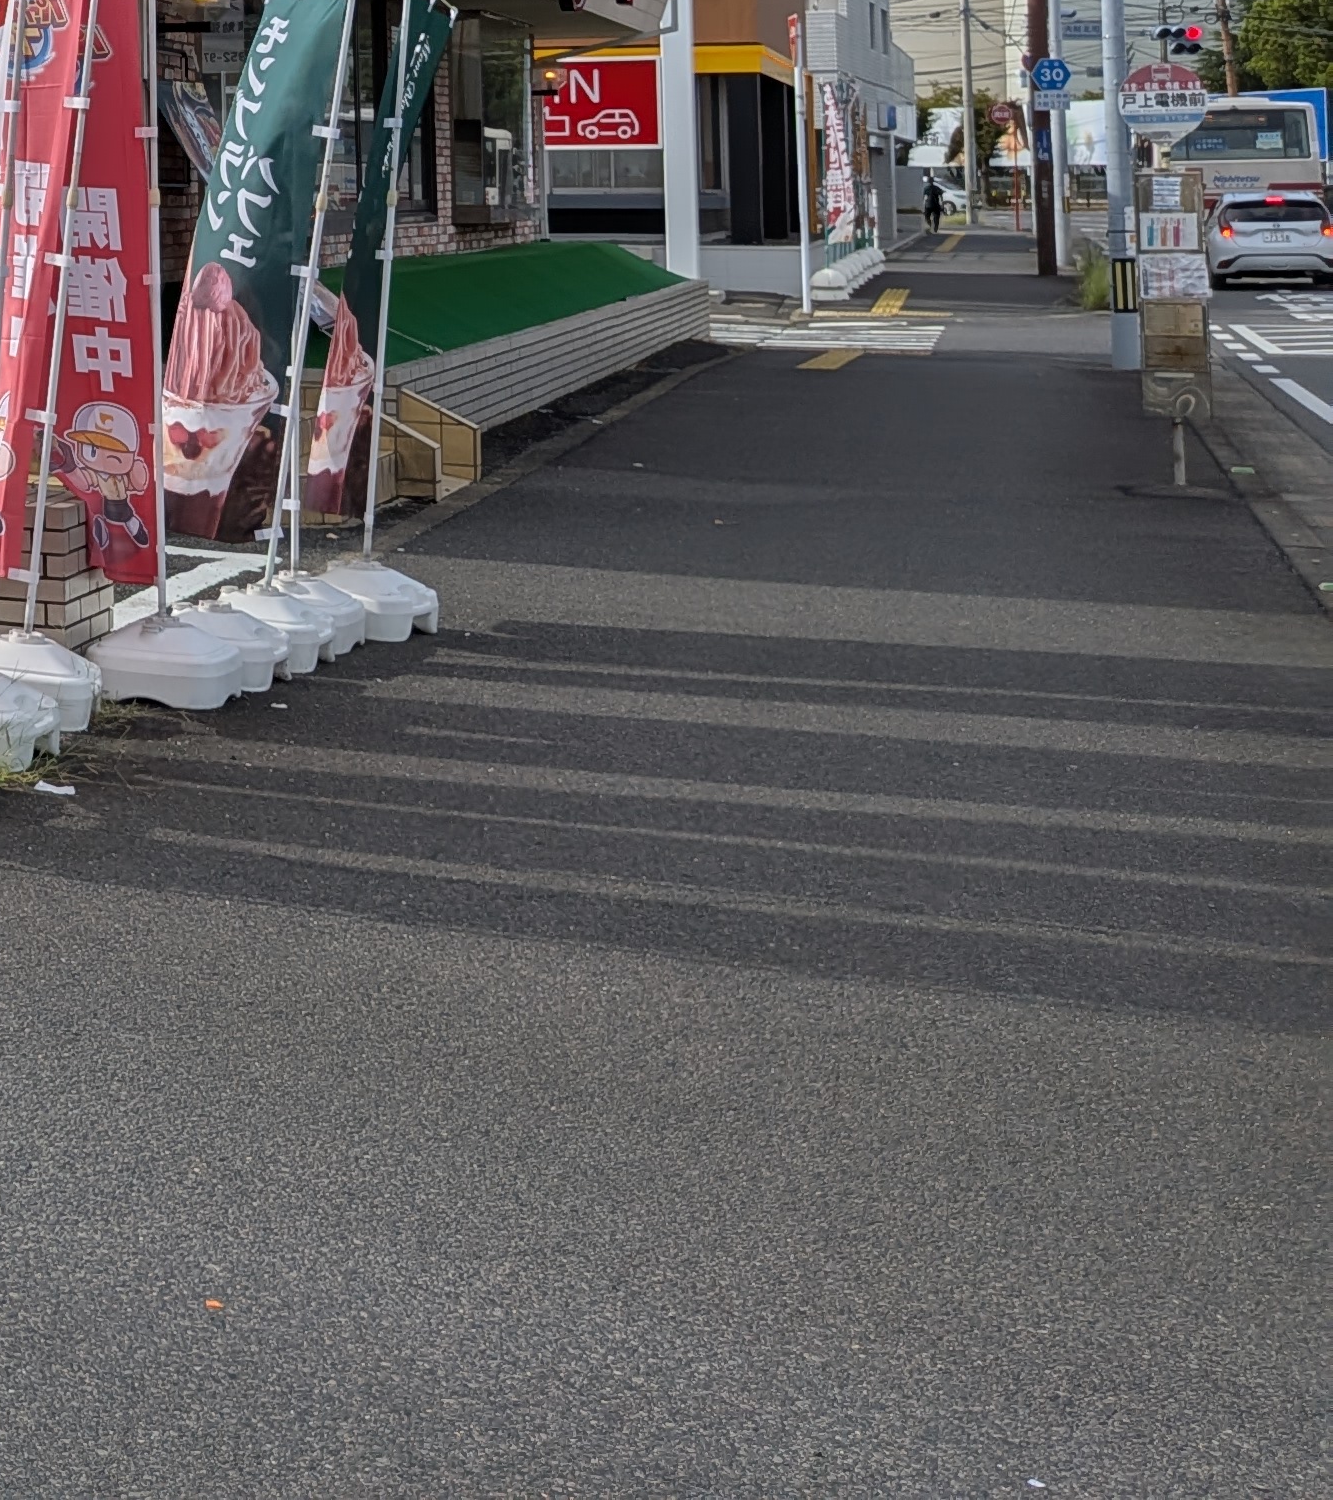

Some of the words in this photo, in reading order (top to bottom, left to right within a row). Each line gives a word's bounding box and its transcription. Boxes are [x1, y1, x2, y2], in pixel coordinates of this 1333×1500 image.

[1040, 67, 1064, 82] 30
[1121, 92, 1206, 109] 戸上電機前
